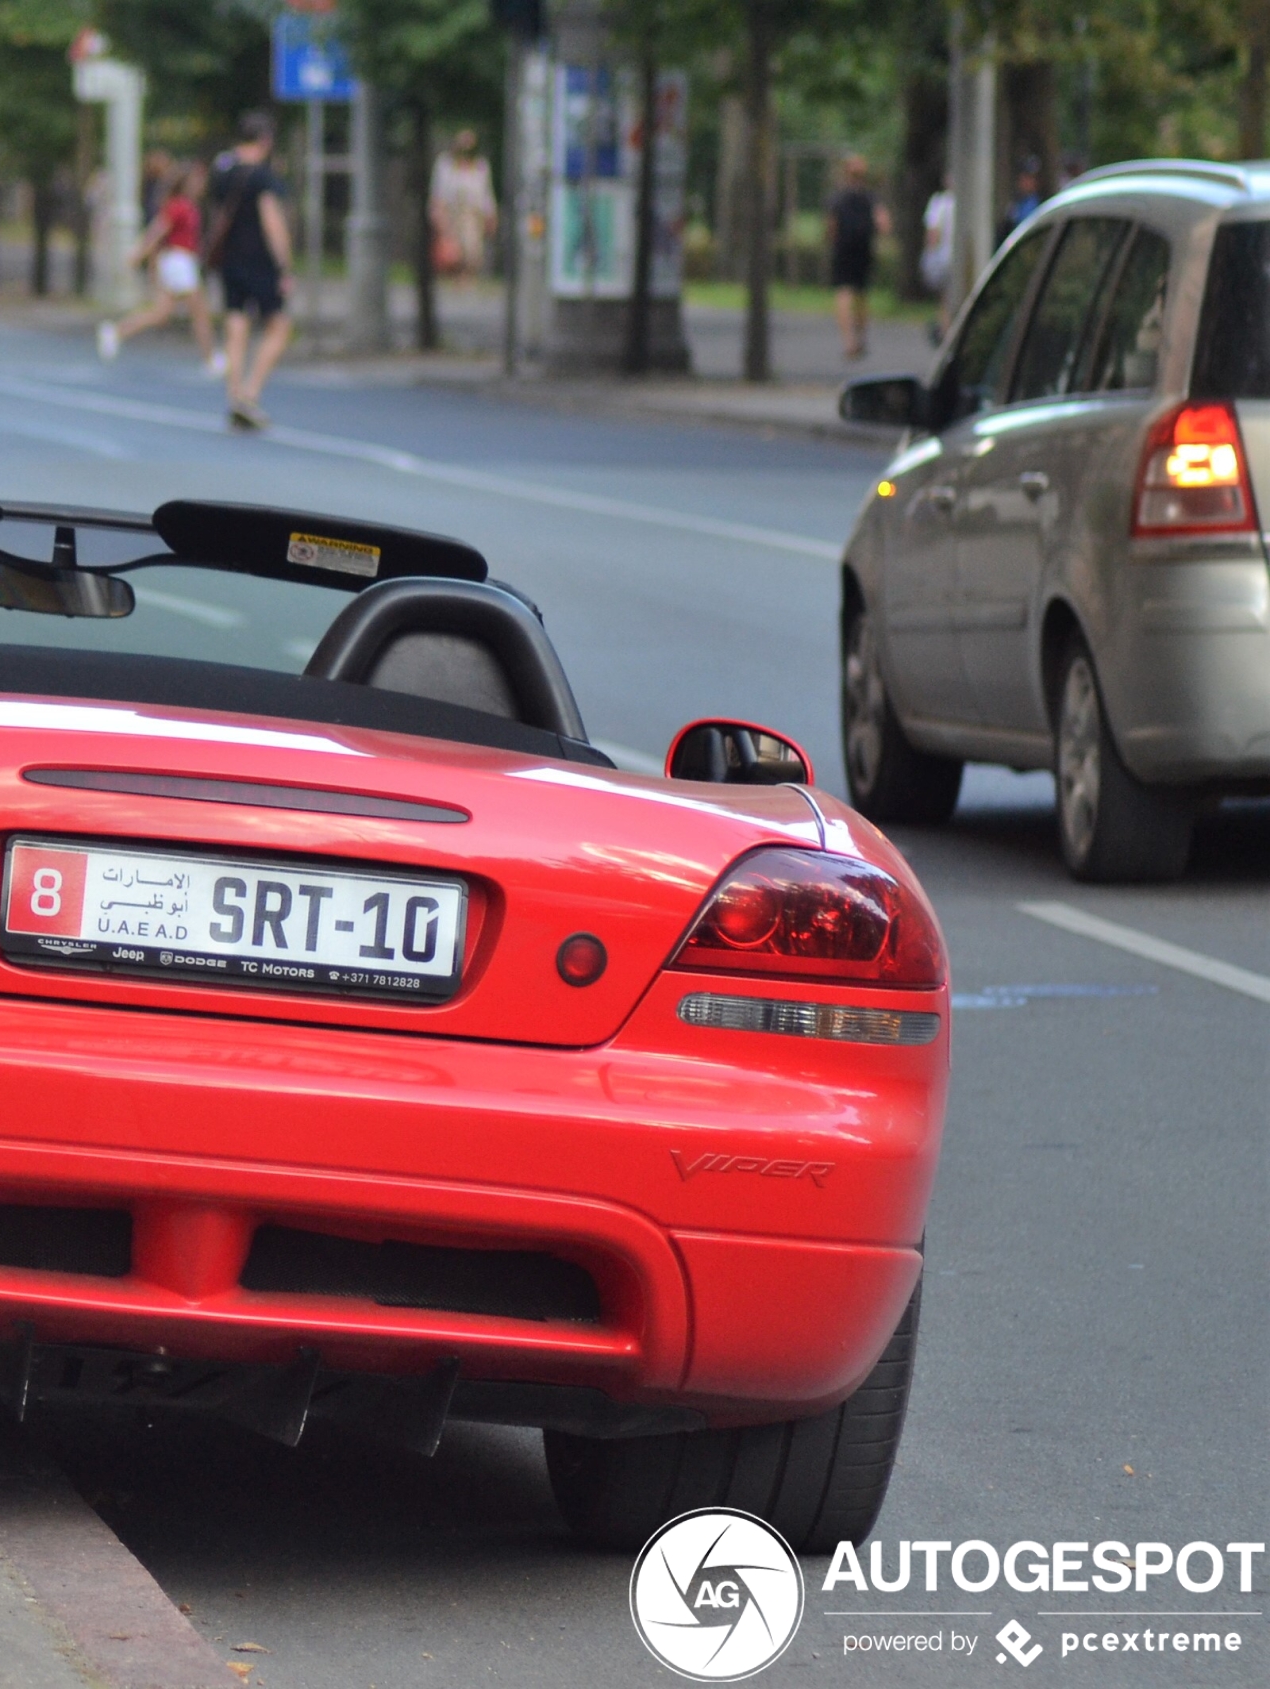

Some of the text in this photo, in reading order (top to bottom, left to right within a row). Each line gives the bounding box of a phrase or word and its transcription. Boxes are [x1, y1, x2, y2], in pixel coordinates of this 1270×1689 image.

[30, 867, 62, 918] 8
[208, 876, 440, 963] SRT-10
[155, 924, 188, 940] A.D
[37, 938, 98, 949] CHRYSLER
[112, 946, 145, 962] Jeep
[174, 955, 227, 968] DODGE
[241, 961, 258, 973] TC
[342, 974, 421, 989] +371 7812828
[669, 1149, 836, 1188] VIPER
